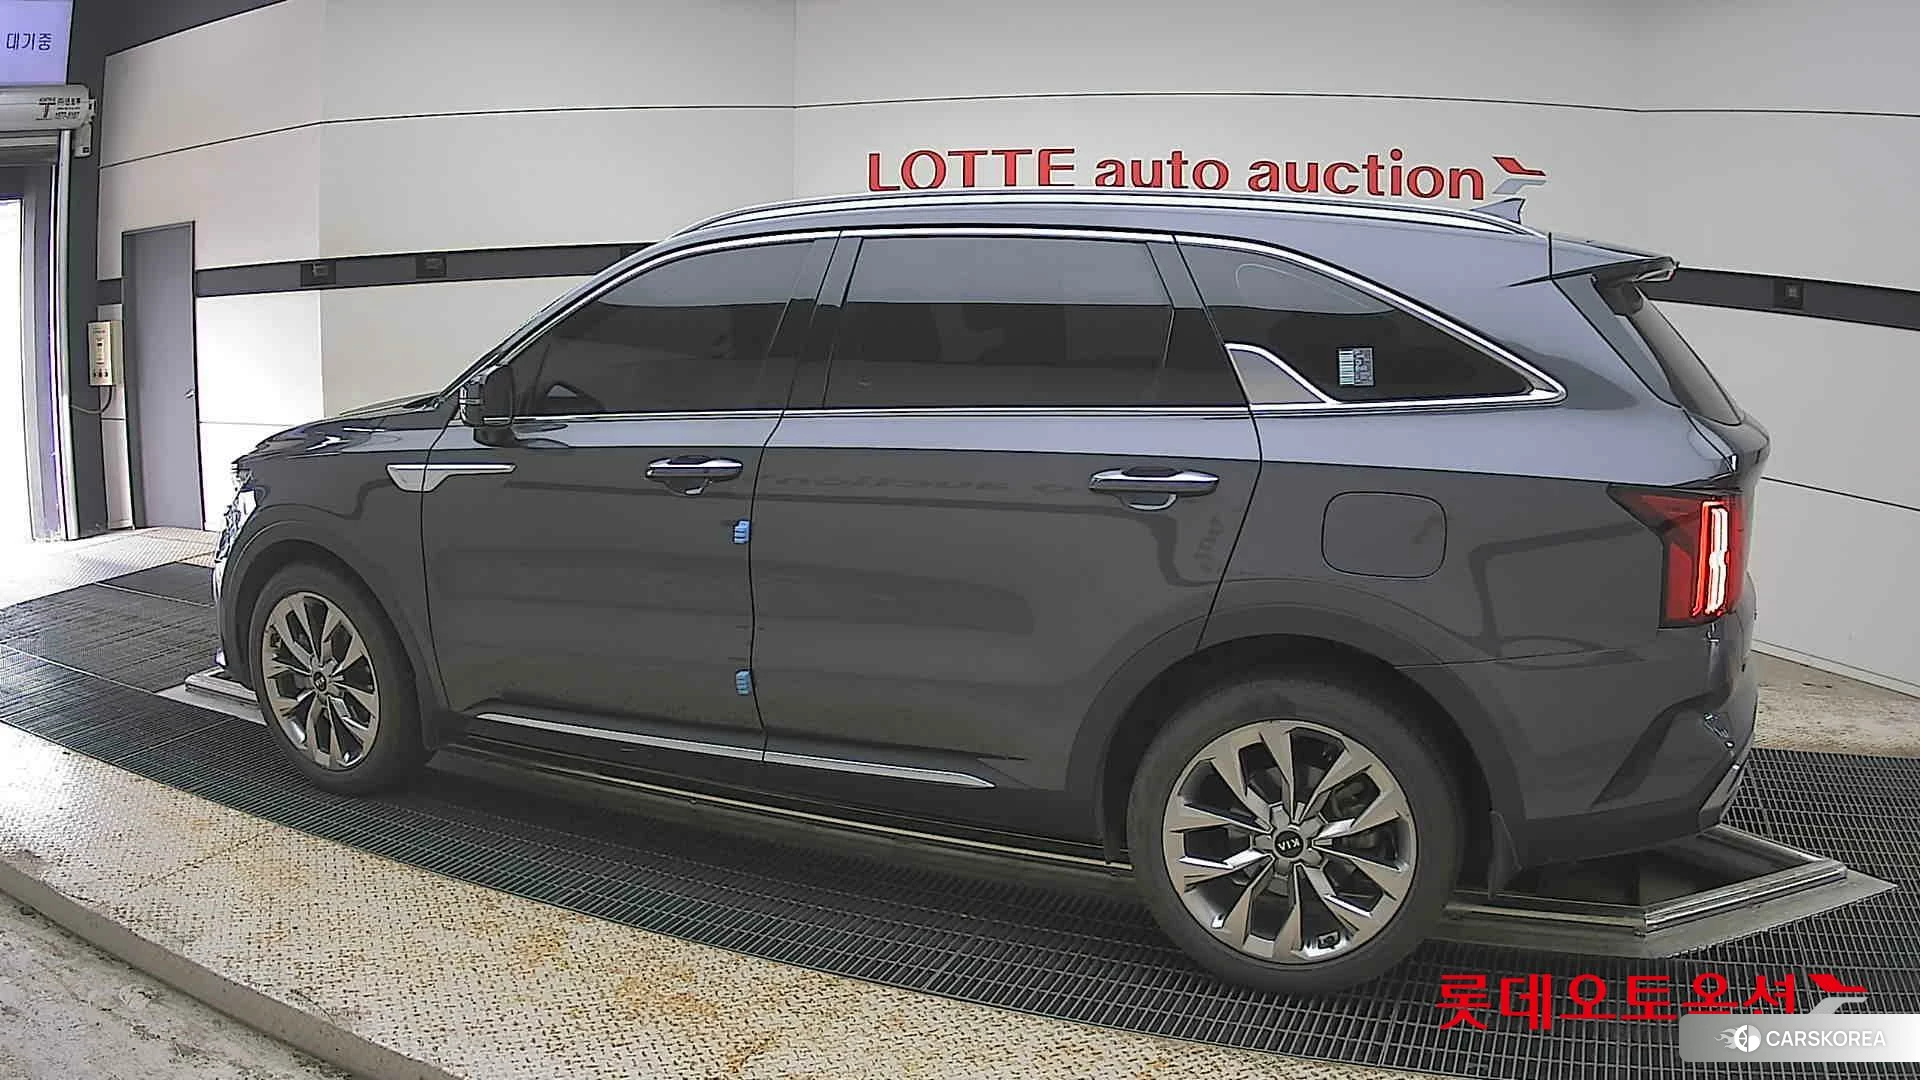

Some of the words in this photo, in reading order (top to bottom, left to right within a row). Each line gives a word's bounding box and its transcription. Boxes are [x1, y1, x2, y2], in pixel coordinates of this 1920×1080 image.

[6, 32, 52, 51] 대기중
[868, 148, 1075, 192] LOTTE
[1095, 151, 1230, 189] auto
[1248, 148, 1485, 200] auction
[1277, 837, 1301, 851] KIA
